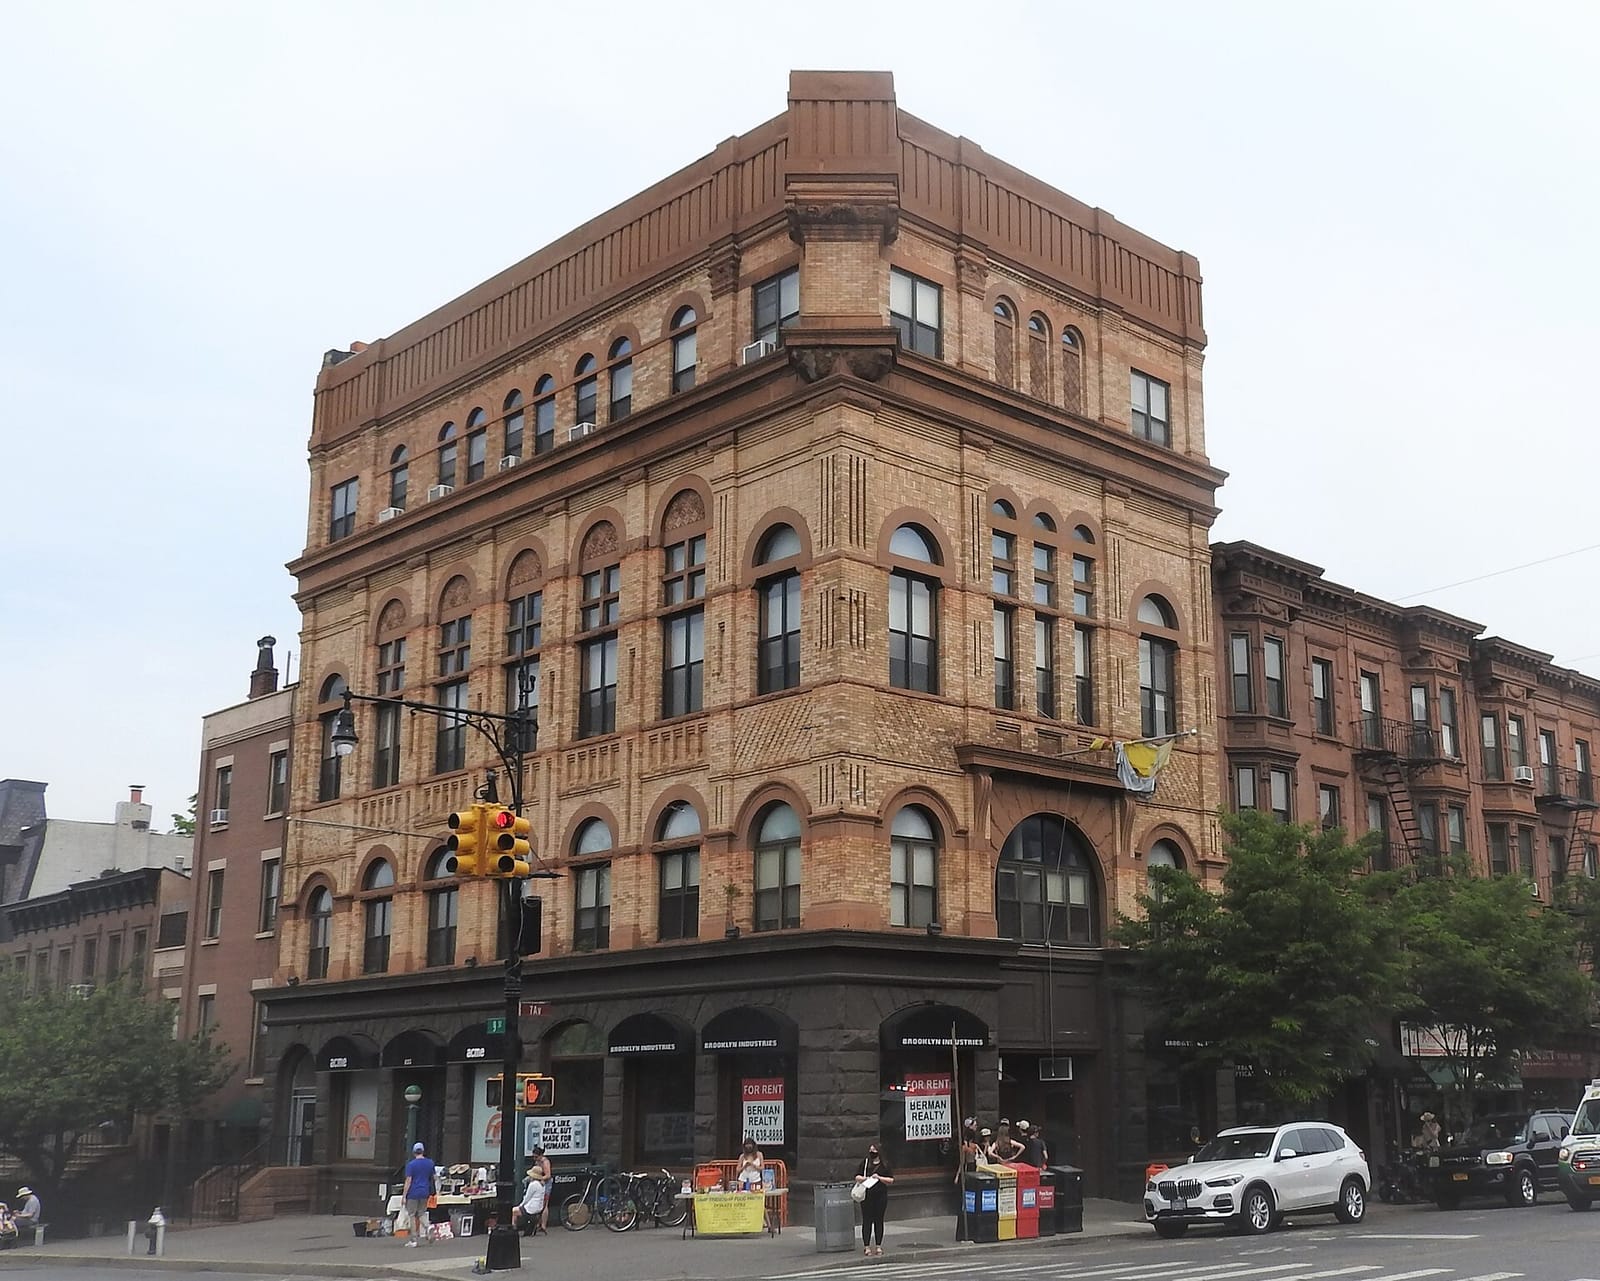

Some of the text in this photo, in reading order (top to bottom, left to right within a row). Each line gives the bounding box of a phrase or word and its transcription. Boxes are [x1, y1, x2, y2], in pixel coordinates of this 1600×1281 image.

[640, 1043, 676, 1051] INDUSTRIES
[704, 1039, 777, 1049] BROOKLYN INDUSTRIES
[466, 1047, 485, 1058] acme
[329, 1057, 347, 1068] acme
[743, 1084, 783, 1095] FOR RENT
[906, 1079, 950, 1090] FOR RENT
[909, 1100, 947, 1110] BERMAN
[747, 1105, 780, 1116] BERMAN
[748, 1116, 779, 1126] REALTY
[911, 1111, 945, 1121] REALTY
[557, 1119, 571, 1127] LIKE
[907, 1124, 919, 1137] 718
[560, 1134, 572, 1142] FOR
[554, 1175, 577, 1184] Station
